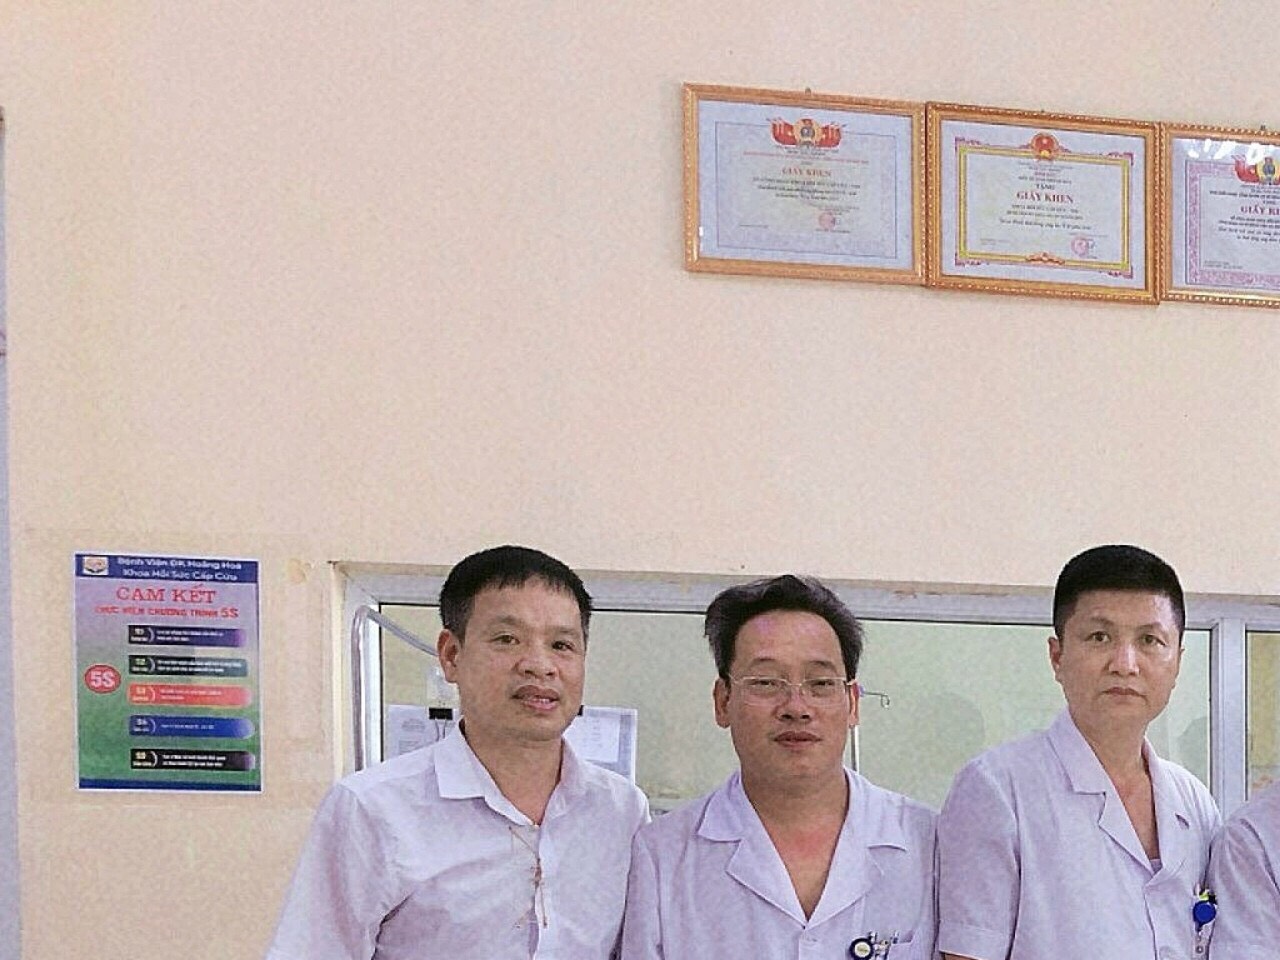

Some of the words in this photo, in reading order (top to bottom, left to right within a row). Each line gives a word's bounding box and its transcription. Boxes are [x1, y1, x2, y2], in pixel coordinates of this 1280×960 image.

[1044, 193, 1074, 203] KHEN
[116, 586, 165, 602] CAM
[171, 584, 216, 603] KẾT
[220, 608, 239, 618] 5S
[90, 670, 115, 688] 5S
